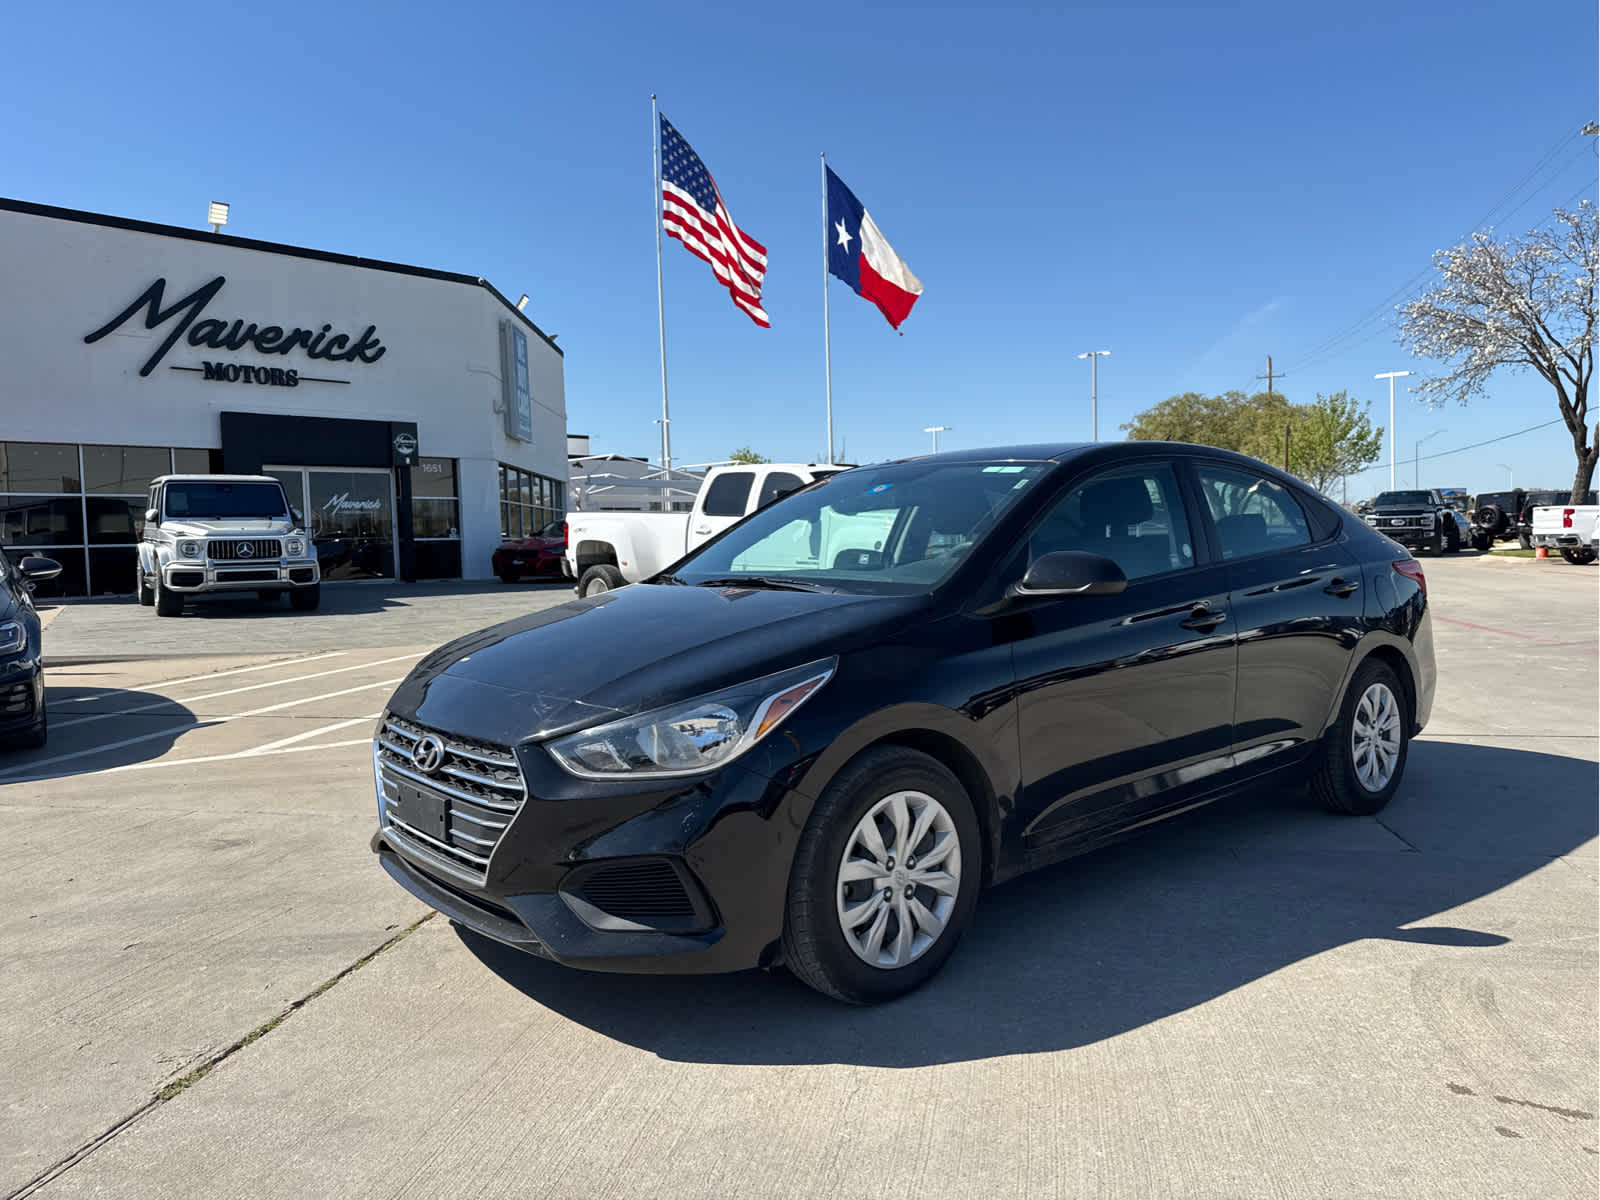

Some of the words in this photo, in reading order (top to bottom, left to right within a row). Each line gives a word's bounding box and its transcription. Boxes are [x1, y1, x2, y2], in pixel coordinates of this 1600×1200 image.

[84, 276, 386, 377] Maverick
[202, 361, 299, 387] MOTORS
[422, 463, 442, 473] 1651
